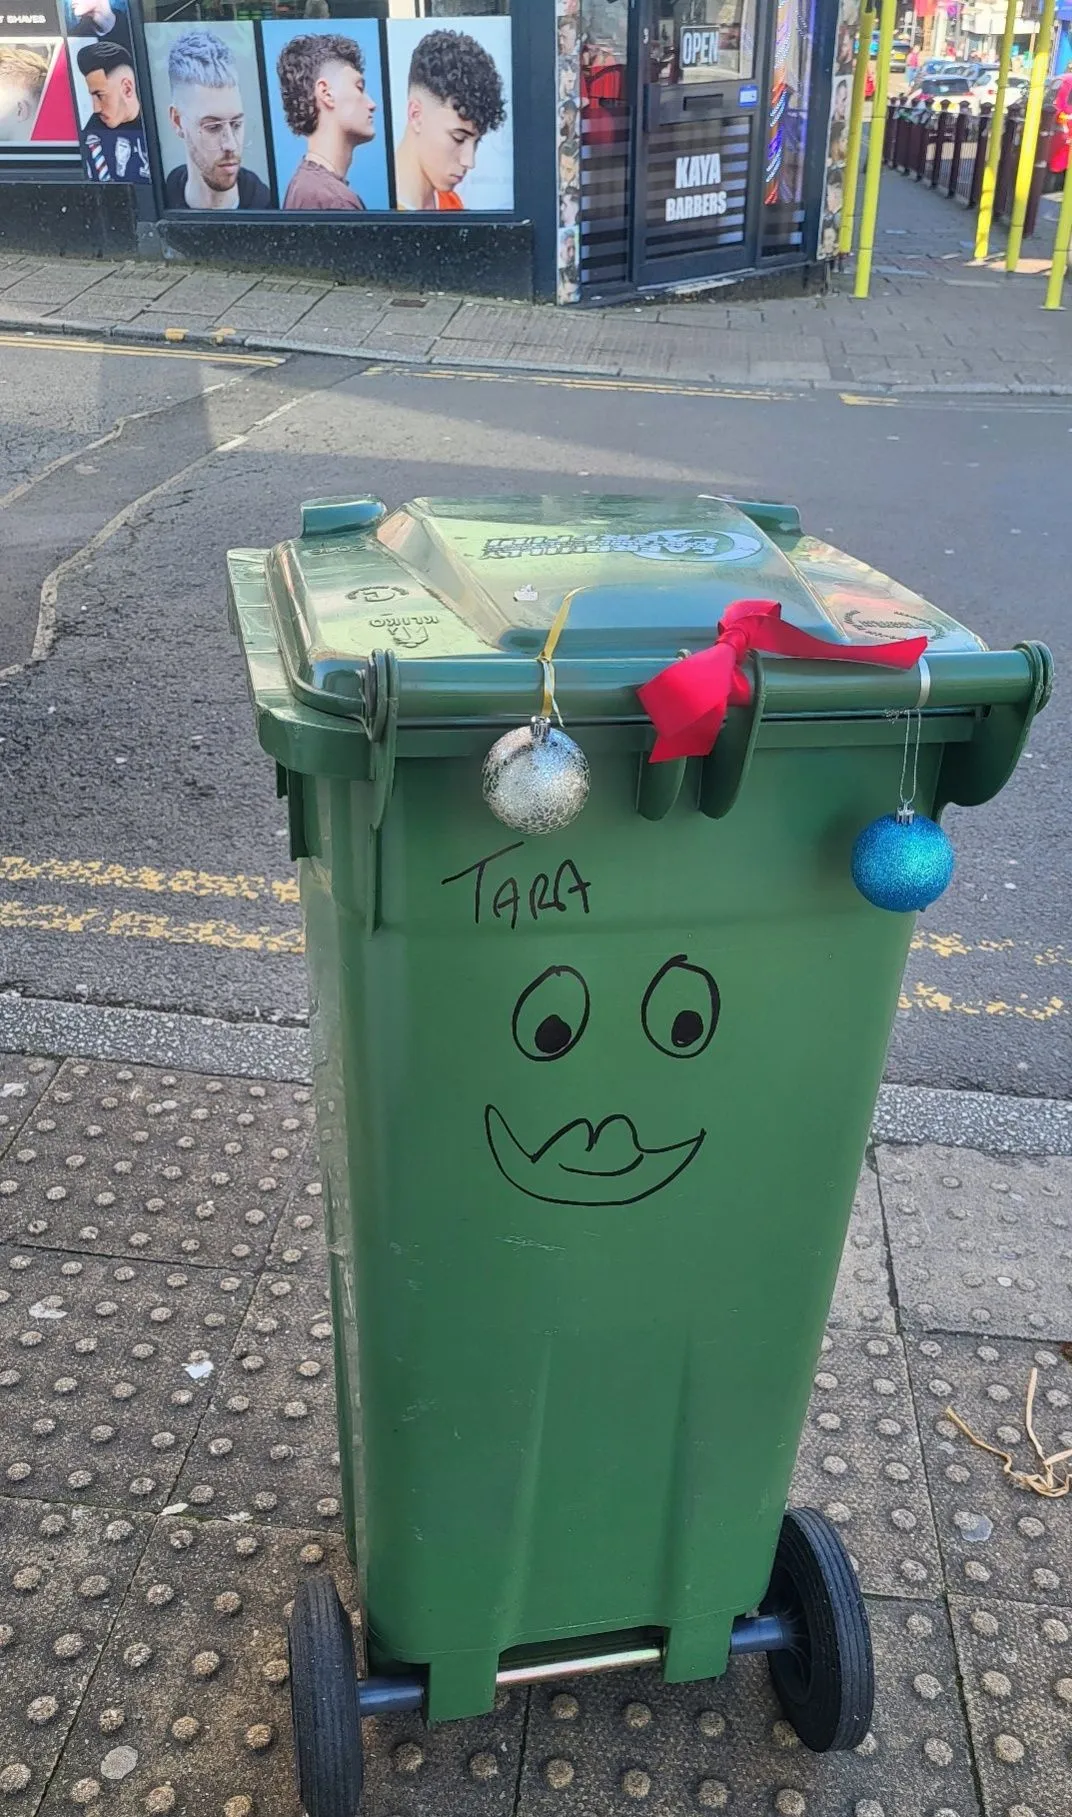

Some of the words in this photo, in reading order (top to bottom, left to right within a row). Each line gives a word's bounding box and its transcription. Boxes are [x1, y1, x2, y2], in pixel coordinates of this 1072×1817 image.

[6, 15, 47, 24] SHAVES
[682, 32, 719, 65] OPEN
[675, 153, 721, 189] KAYA
[665, 191, 727, 222] BARBERS
[441, 841, 591, 930] TARA
